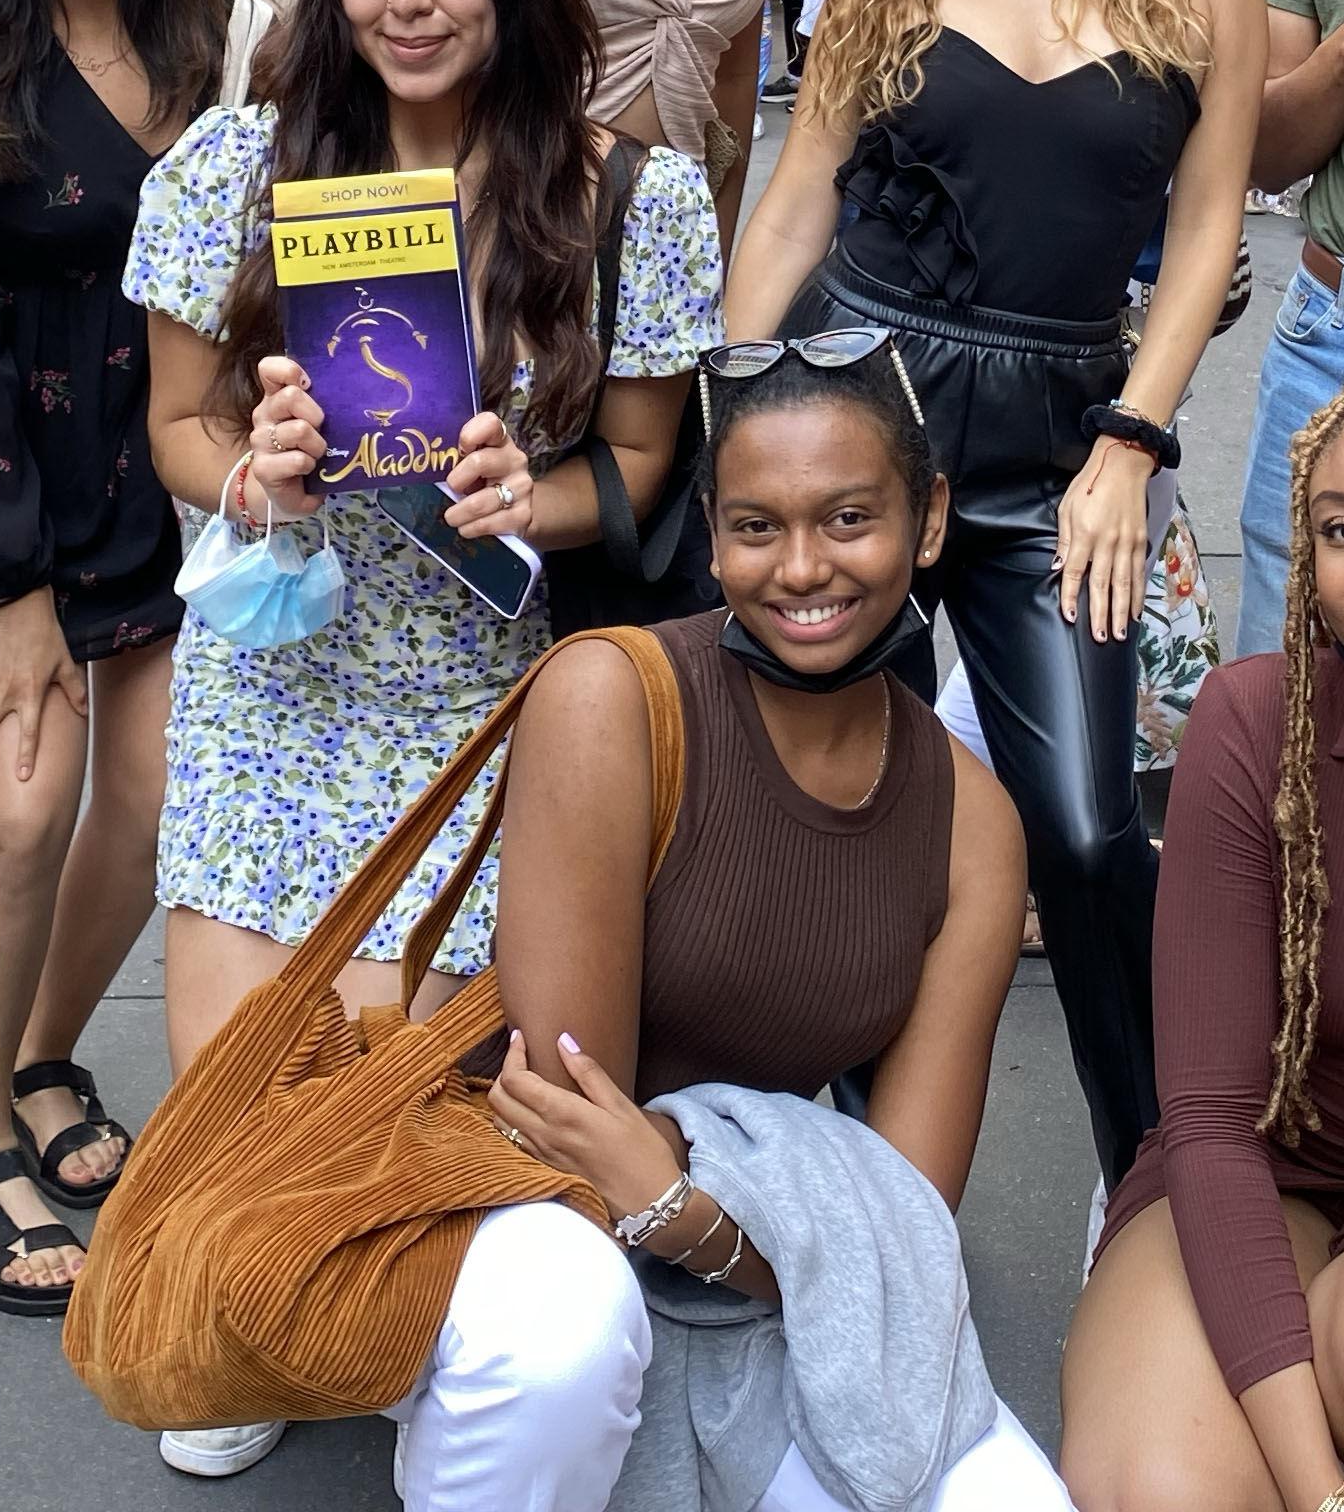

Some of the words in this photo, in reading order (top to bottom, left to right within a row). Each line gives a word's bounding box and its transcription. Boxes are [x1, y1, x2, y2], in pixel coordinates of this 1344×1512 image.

[320, 187, 363, 204] SHOP
[367, 183, 409, 200] NOW!
[279, 222, 445, 260] PLAYBILL
[322, 263, 337, 271] NEW
[379, 256, 407, 265] THEATRE
[319, 428, 459, 484] Aladdin
